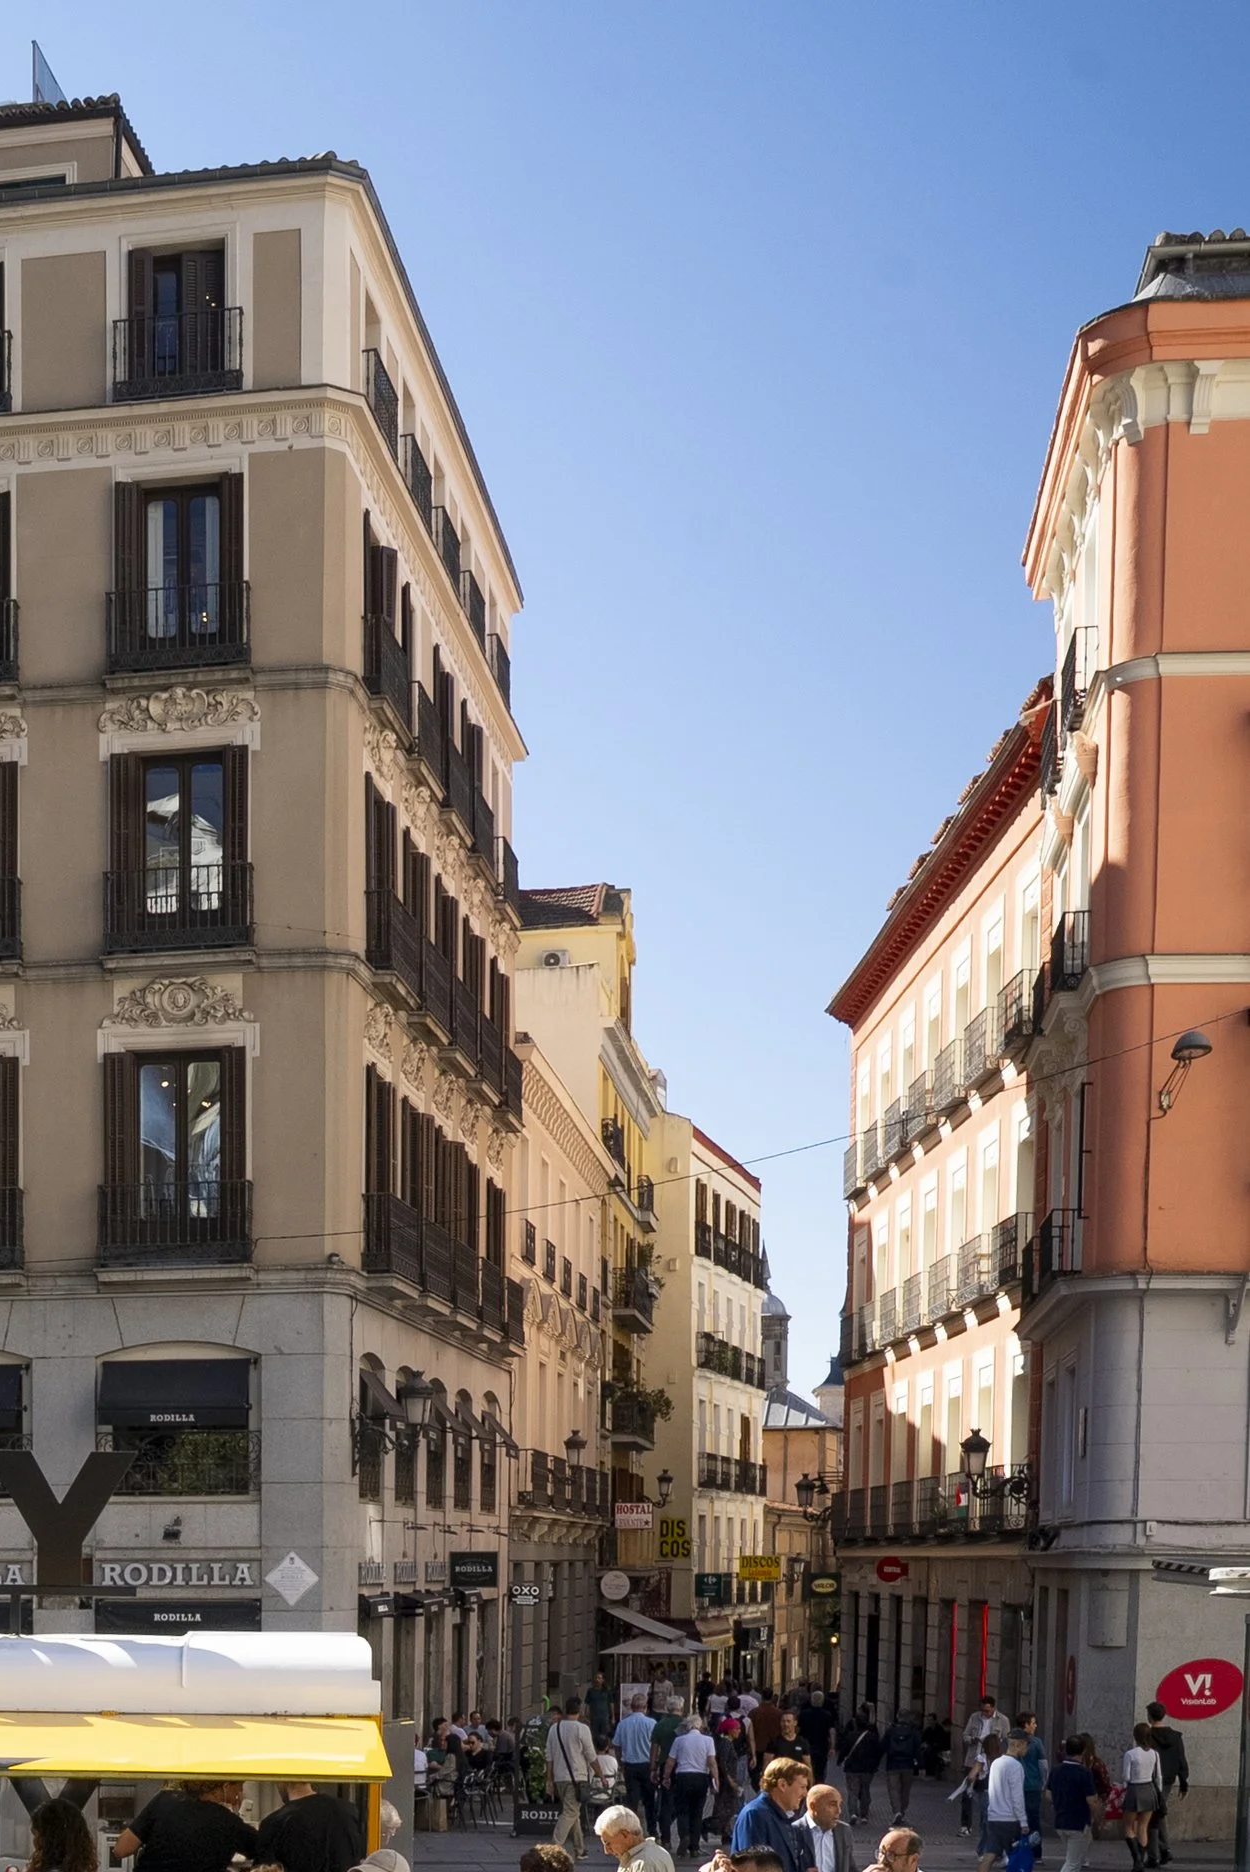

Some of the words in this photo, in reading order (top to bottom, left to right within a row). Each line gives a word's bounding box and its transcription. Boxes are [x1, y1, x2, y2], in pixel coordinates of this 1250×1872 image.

[150, 1414, 195, 1422] RODILLA
[616, 1504, 653, 1515] HOSTAL
[660, 1519, 686, 1538] DIS
[660, 1540, 691, 1558] COS
[741, 1556, 781, 1568] DISCOS
[101, 1562, 254, 1586] RODILLA
[512, 1585, 540, 1595] OXO
[154, 1613, 202, 1622] RODILLA
